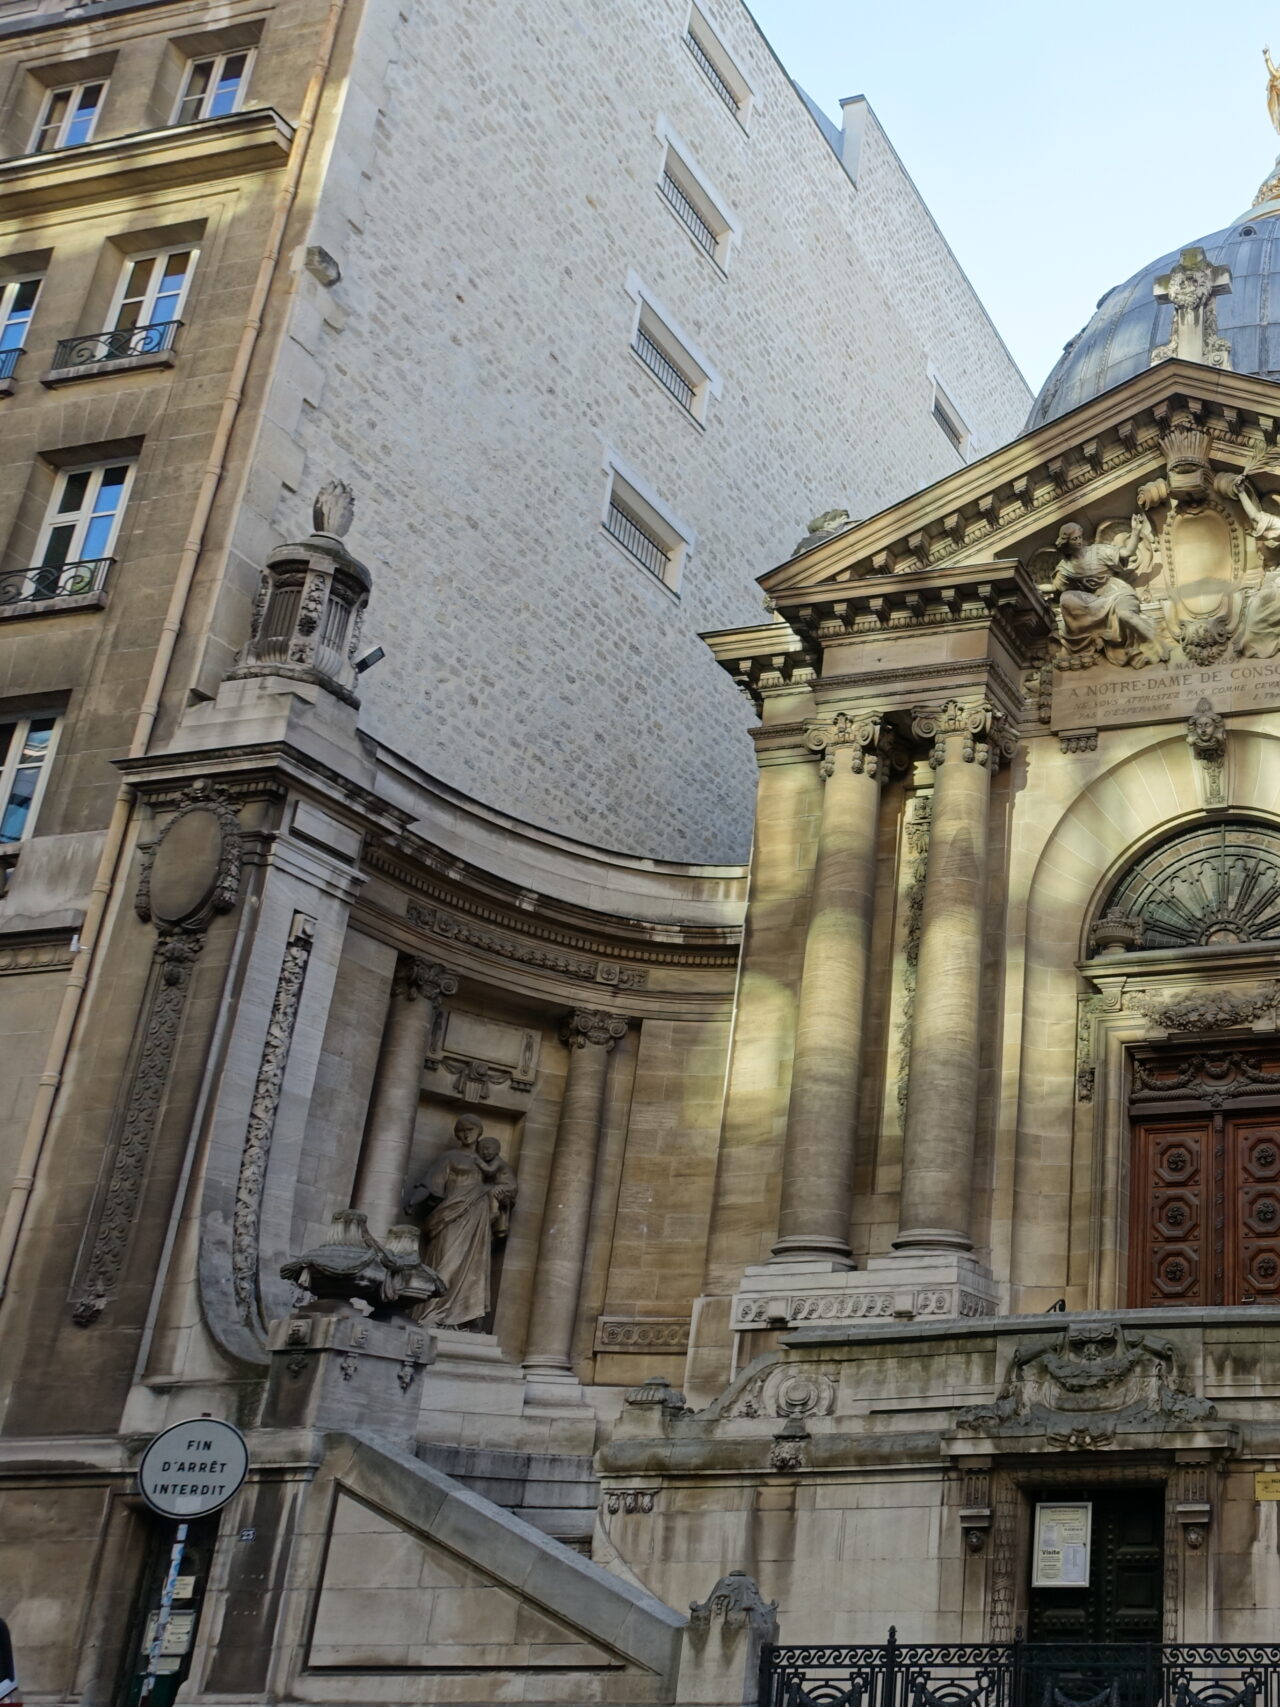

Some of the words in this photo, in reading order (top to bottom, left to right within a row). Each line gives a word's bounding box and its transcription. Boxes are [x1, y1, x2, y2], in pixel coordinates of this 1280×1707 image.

[1069, 688, 1079, 698] A
[1086, 674, 1193, 698] NOTRE-DAME
[1200, 670, 1223, 684] DE
[1187, 688, 1207, 699] PAS
[186, 1440, 213, 1451] FIN
[161, 1461, 228, 1474] D'ARRÊT
[152, 1484, 227, 1496] INTERDIT
